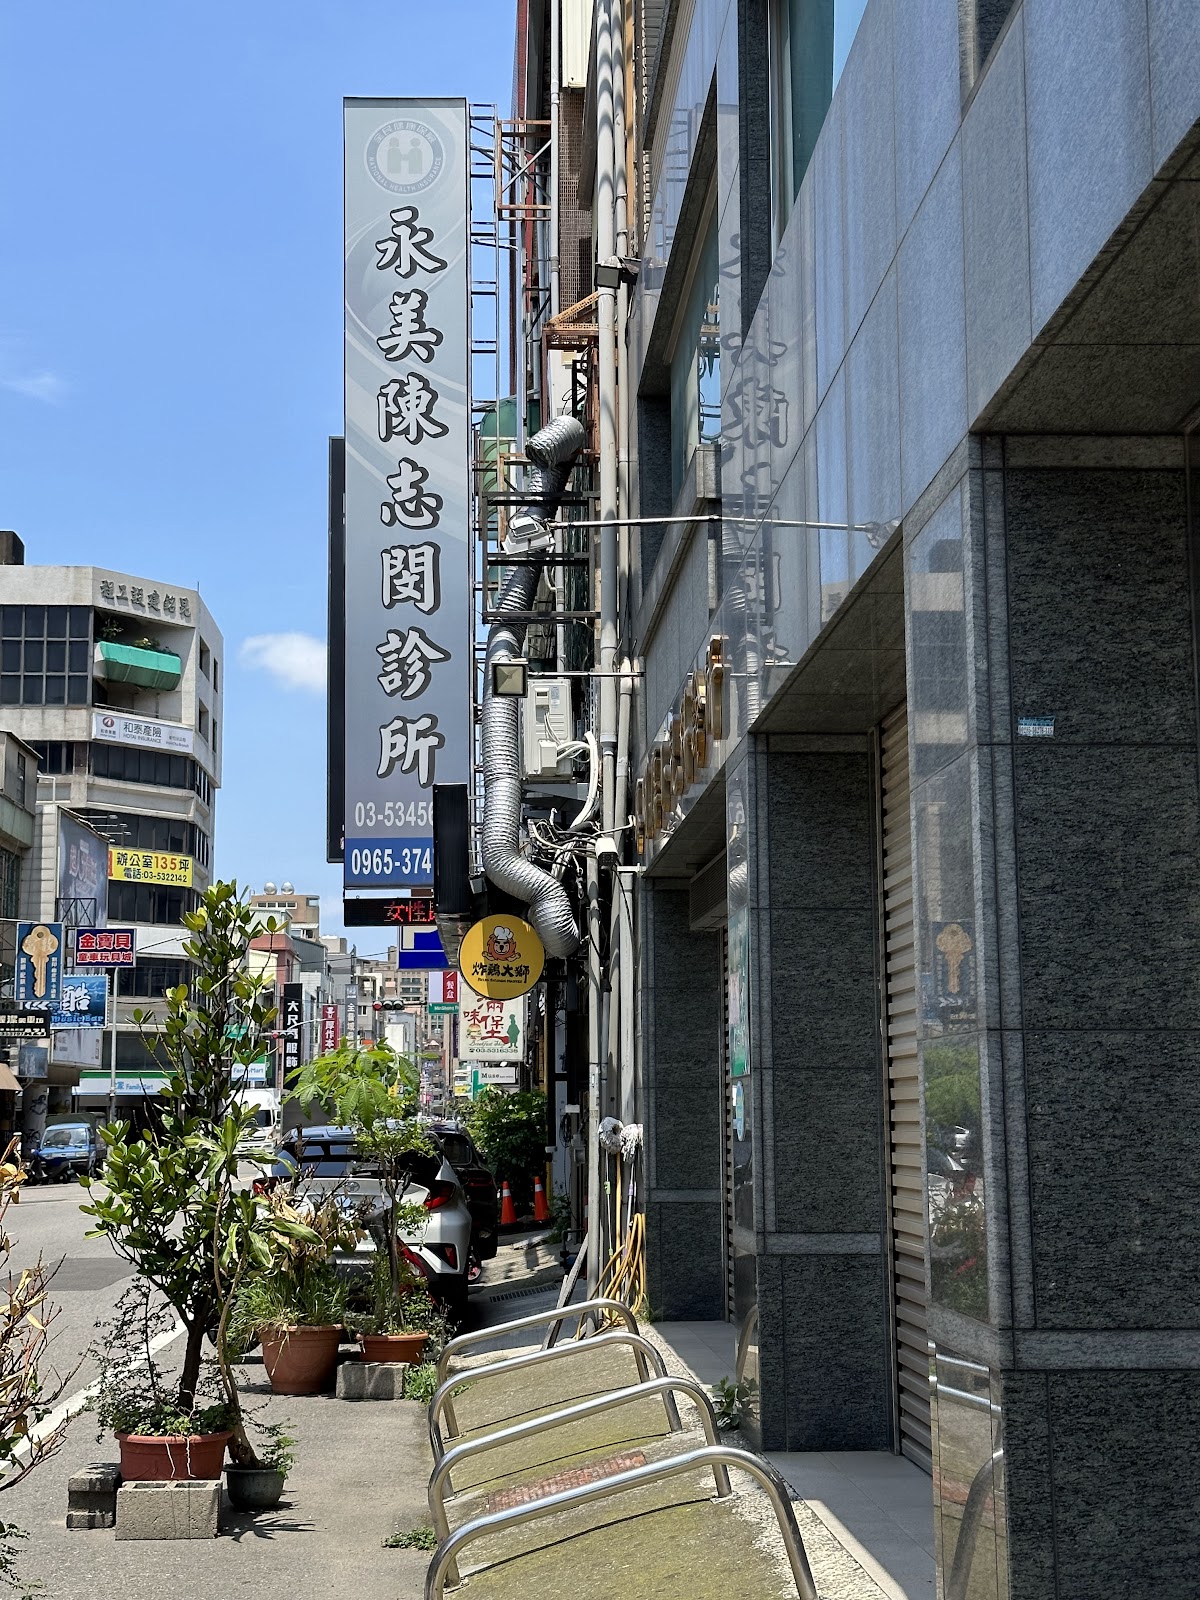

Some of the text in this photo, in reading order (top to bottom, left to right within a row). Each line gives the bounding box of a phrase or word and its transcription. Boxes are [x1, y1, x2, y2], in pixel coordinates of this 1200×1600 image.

[368, 156, 442, 192] NATIONAL HEALTH INSURANCE
[375, 205, 451, 789] 永美陳志閔診所
[123, 733, 137, 741] HOTAI
[138, 735, 162, 744] INSURANCE
[124, 722, 162, 738] 和泰產險
[116, 852, 189, 872] 辦公室135坪
[351, 848, 434, 876] 0965-374
[124, 867, 188, 883] 電話:03-5322142
[79, 933, 131, 949] 金寶貝
[77, 952, 132, 963] 童車玩具城
[62, 982, 91, 1011] 酷
